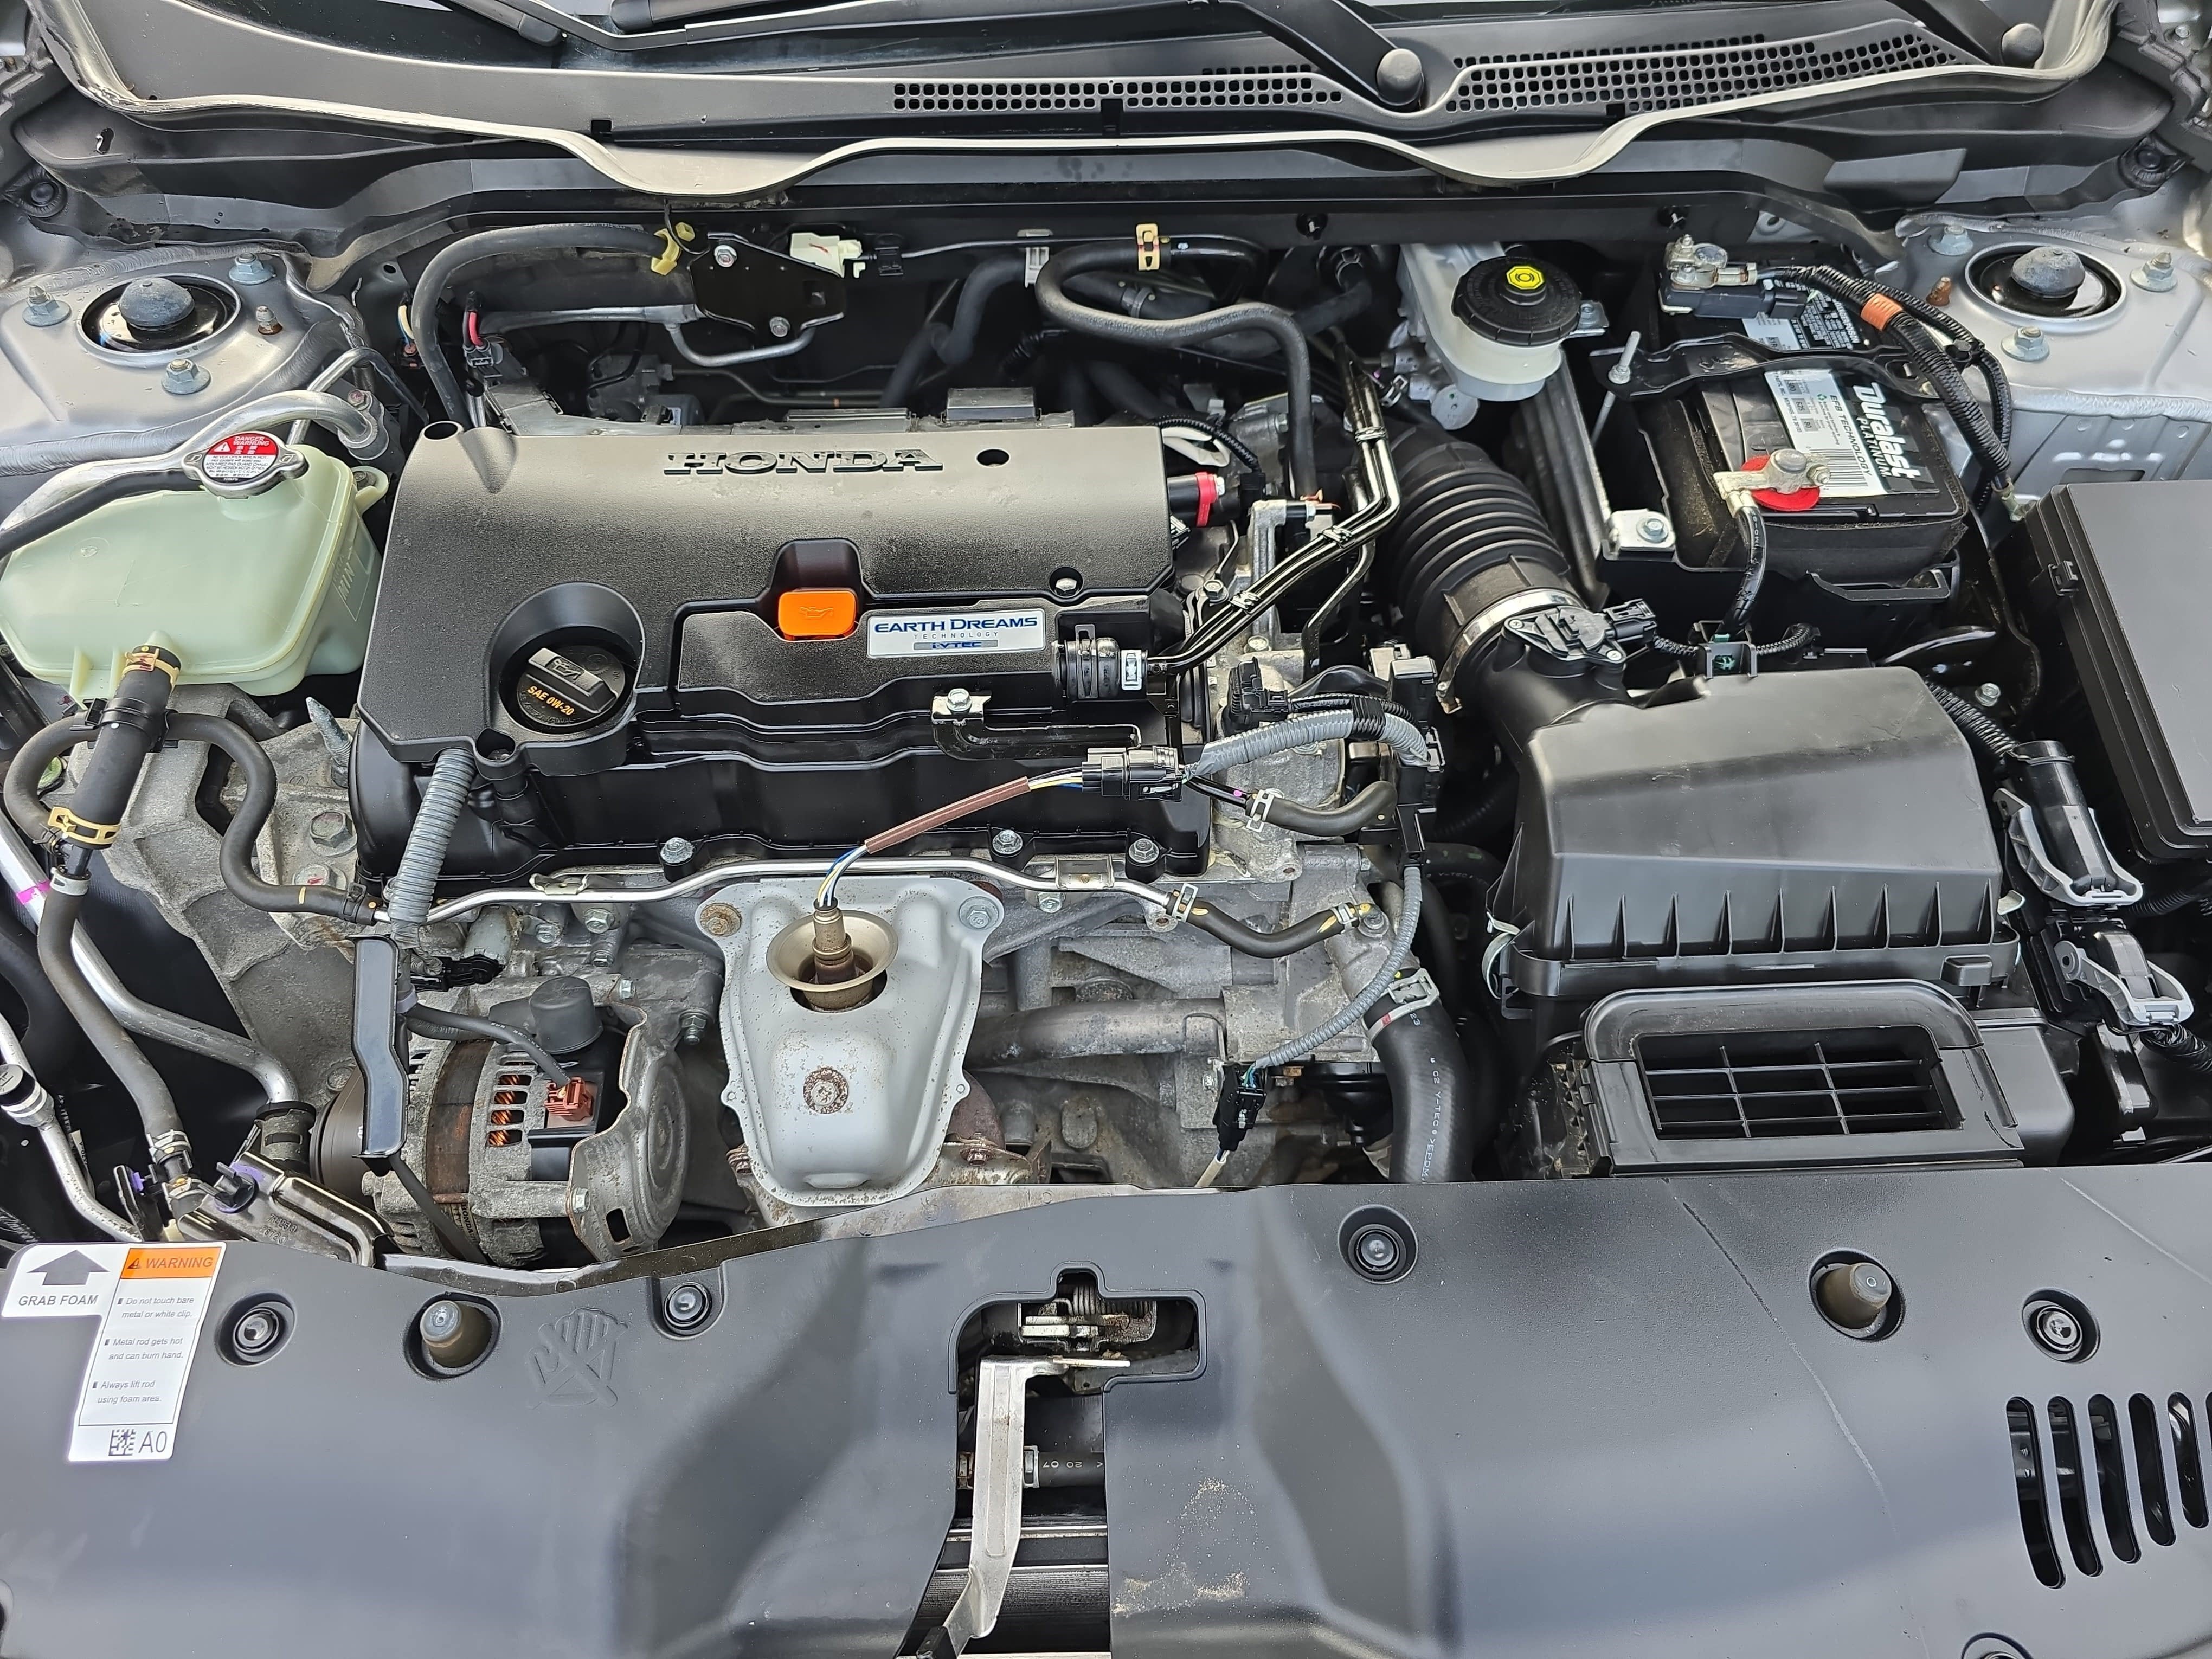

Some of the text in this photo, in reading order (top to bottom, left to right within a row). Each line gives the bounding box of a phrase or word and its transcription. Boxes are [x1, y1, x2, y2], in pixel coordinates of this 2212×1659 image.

[1830, 395, 1872, 476] EFB TECHNOLOGY
[1853, 382, 1921, 479] Duralast
[1856, 417, 1892, 477] PLATINUM
[664, 449, 944, 475] HONDA
[874, 617, 1038, 633] EARTH DREAMS
[914, 631, 999, 640] TECHNOLOGY
[527, 686, 575, 716] SAE 0W-20
[1410, 1012, 1420, 1026] 23
[1433, 1091, 1441, 1127] Y-TEC
[146, 1257, 213, 1269] WARNING
[18, 1295, 99, 1306] GRAB FOAM
[177, 1310, 192, 1319] clip.
[113, 1338, 136, 1346] Metal
[137, 1338, 150, 1346] rod
[151, 1338, 168, 1347] gets
[100, 1381, 128, 1390] Always
[98, 1396, 118, 1404] using
[138, 1431, 168, 1453] A0
